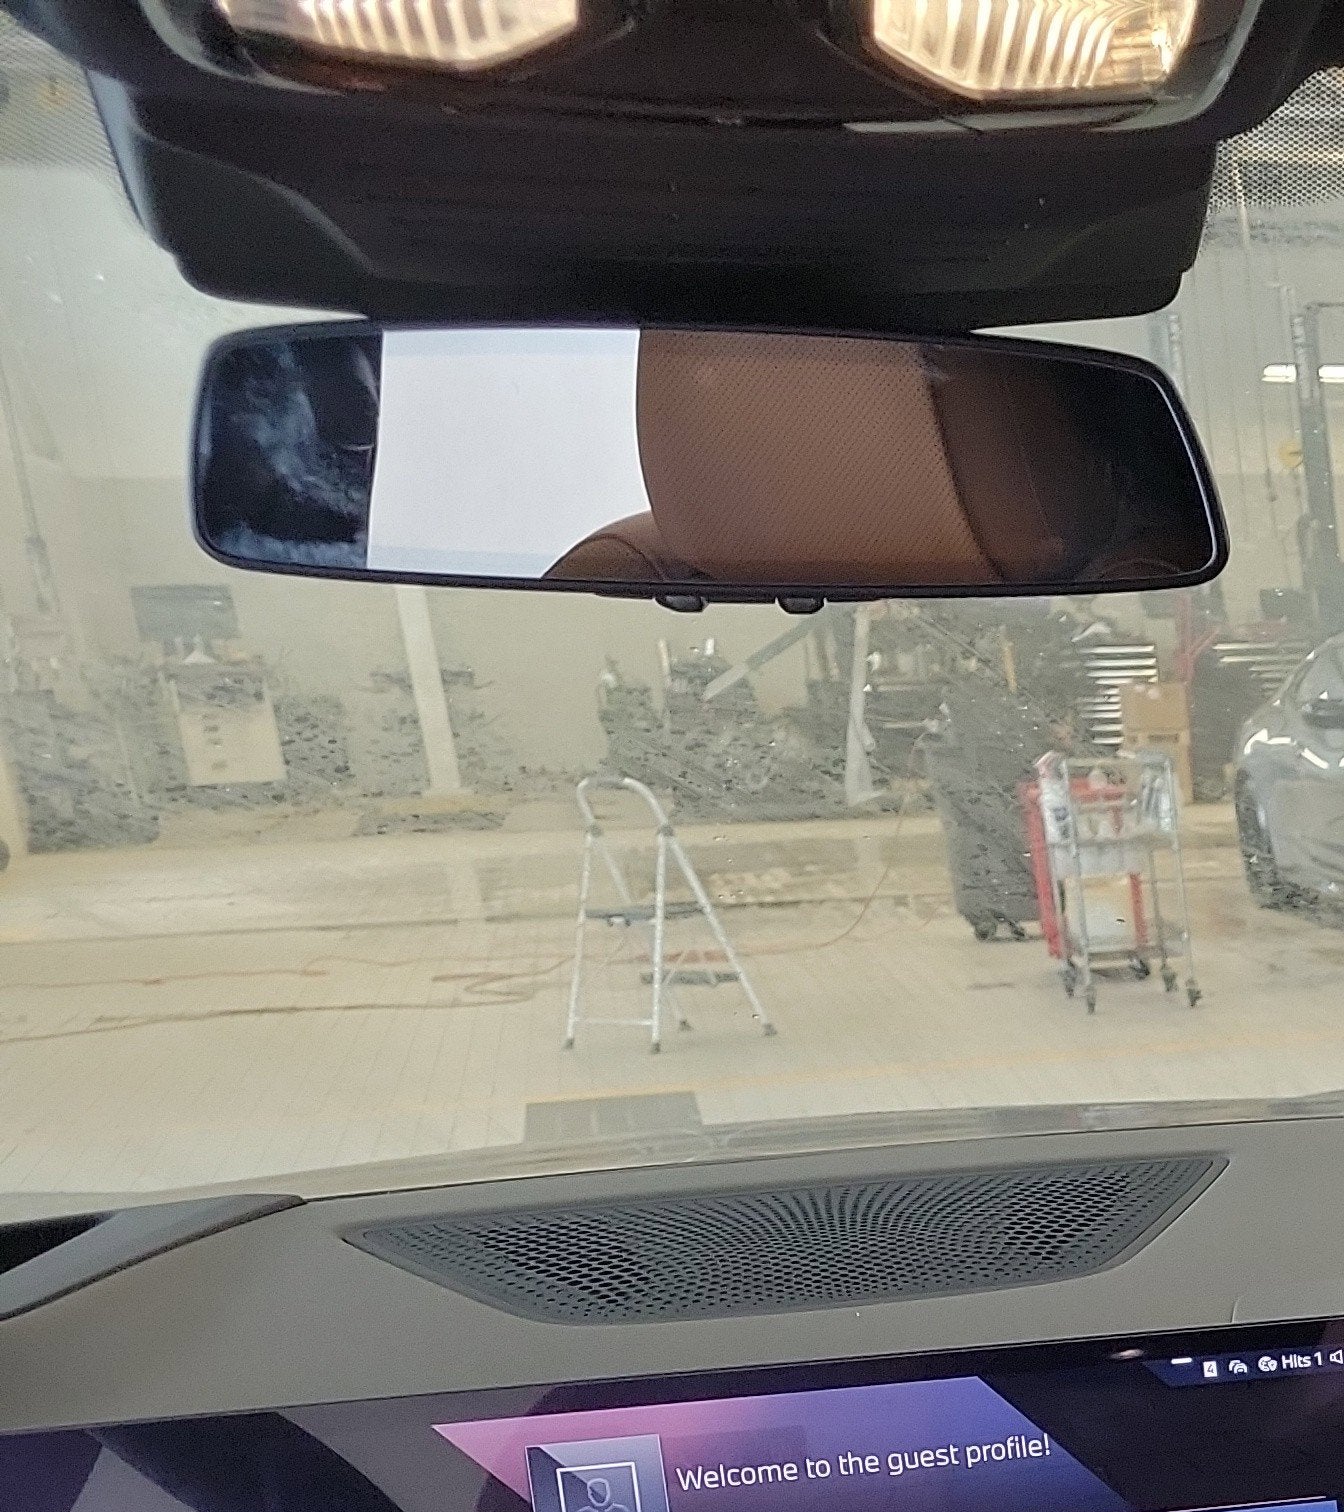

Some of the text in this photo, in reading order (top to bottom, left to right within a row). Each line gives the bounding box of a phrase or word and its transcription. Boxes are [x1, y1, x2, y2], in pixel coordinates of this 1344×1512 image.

[1282, 1354, 1312, 1369] Hits
[1314, 1352, 1323, 1366] 1
[676, 1433, 1052, 1491] Welcome to the guest profile!
